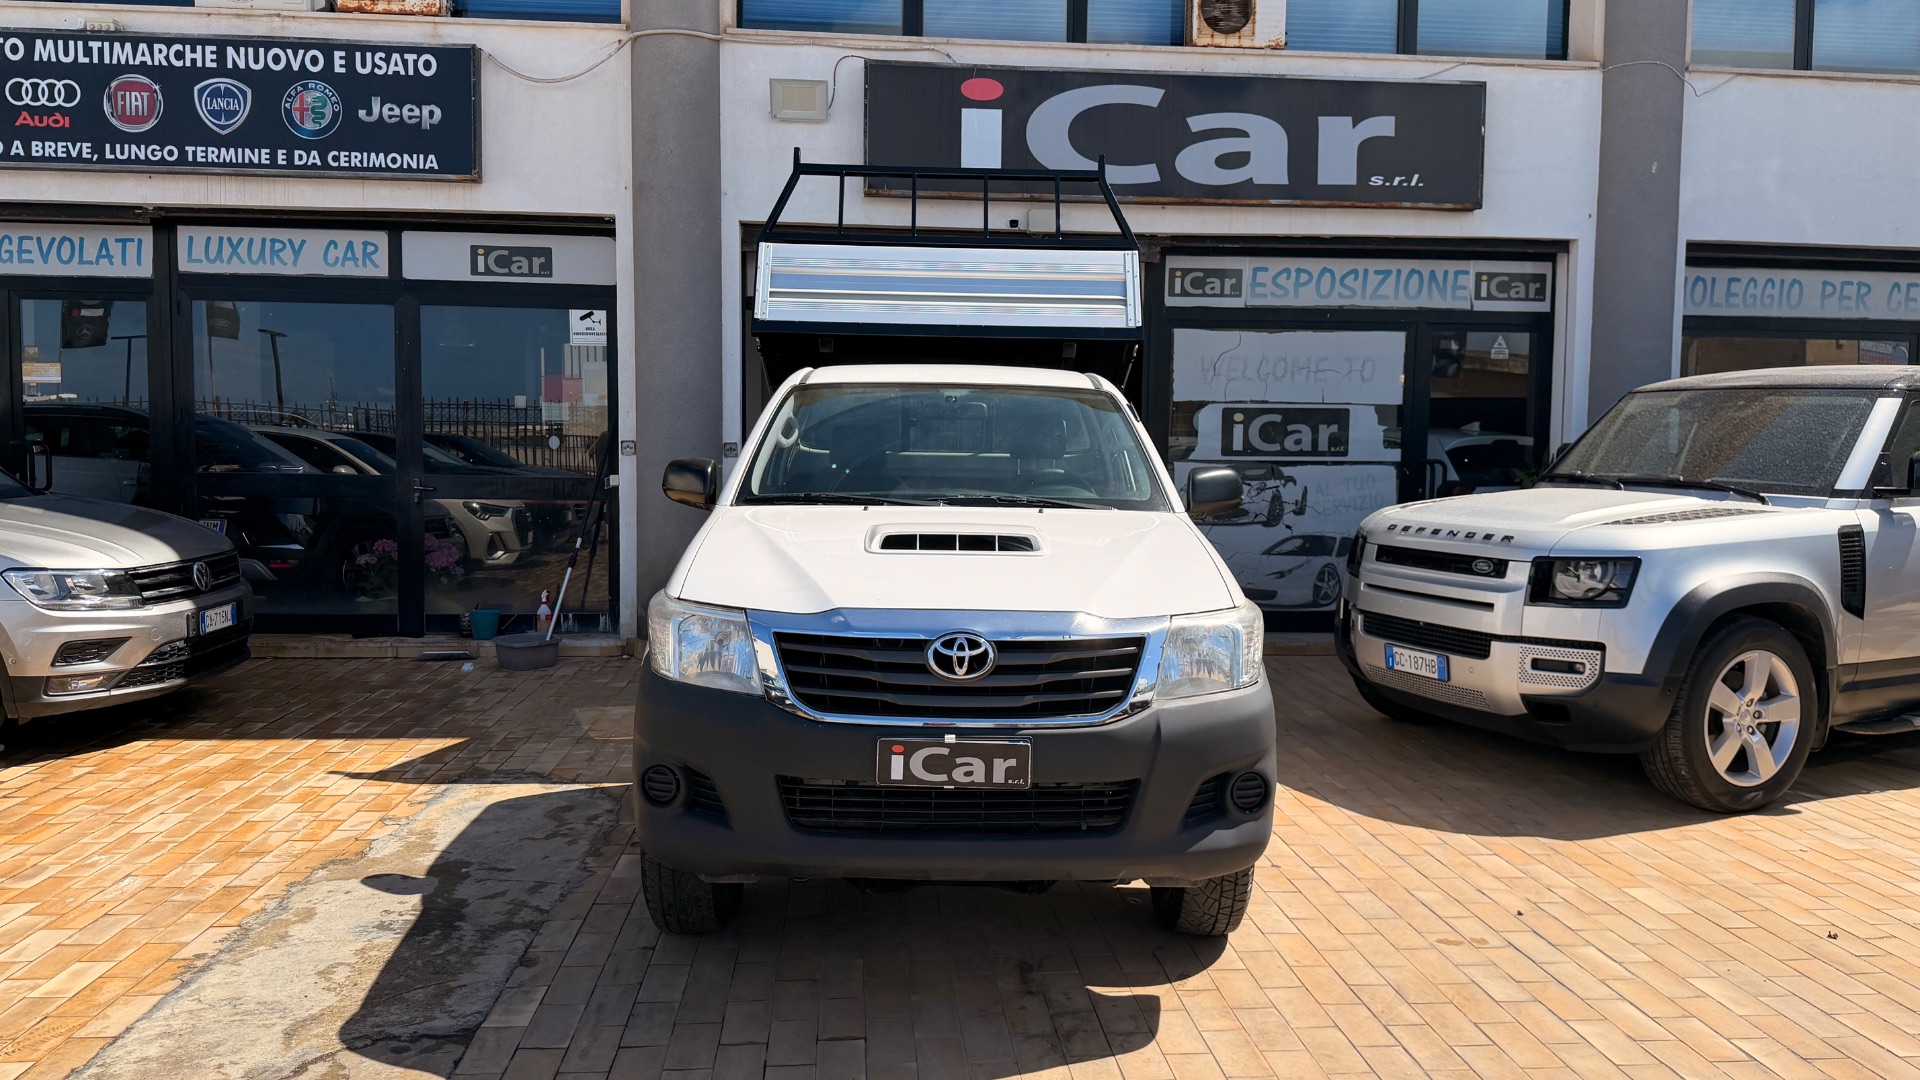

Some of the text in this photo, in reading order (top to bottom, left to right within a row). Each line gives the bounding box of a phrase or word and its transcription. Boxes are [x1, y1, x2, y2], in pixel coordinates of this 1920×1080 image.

[33, 38, 218, 68] MULTIMARCHE
[226, 46, 325, 73] NUOVO
[333, 50, 347, 73] E
[355, 51, 438, 77] USATO
[116, 90, 151, 116] FIAT
[206, 96, 240, 112] LANCIA
[284, 82, 340, 112] ALFA ROMEO
[14, 111, 70, 128] Audi
[358, 96, 442, 130] Jeep
[960, 78, 1424, 187] iCar s.r.l.
[9, 140, 25, 156] A
[31, 141, 99, 162] BREVE,
[105, 143, 179, 162] LUNGO
[185, 146, 271, 165] TERMINE
[277, 149, 287, 165] E
[294, 150, 322, 166] DA
[327, 151, 439, 170] CERIMONIA
[0, 234, 143, 267] GEVOLATI
[186, 235, 380, 269] LUXURY CAR
[476, 248, 546, 275] iCar
[1174, 270, 1236, 295] iCar
[1250, 266, 1470, 302] ESPOSIZIONE
[1480, 274, 1541, 299] iCar
[1819, 279, 1872, 313] PER
[1886, 281, 1920, 314] CE
[1200, 354, 1377, 384] WELCOME TO
[1232, 412, 1339, 452] iCar
[1315, 473, 1376, 497] AL TUO
[1387, 524, 1515, 543] DEFENDER
[890, 744, 1017, 784] iCar
